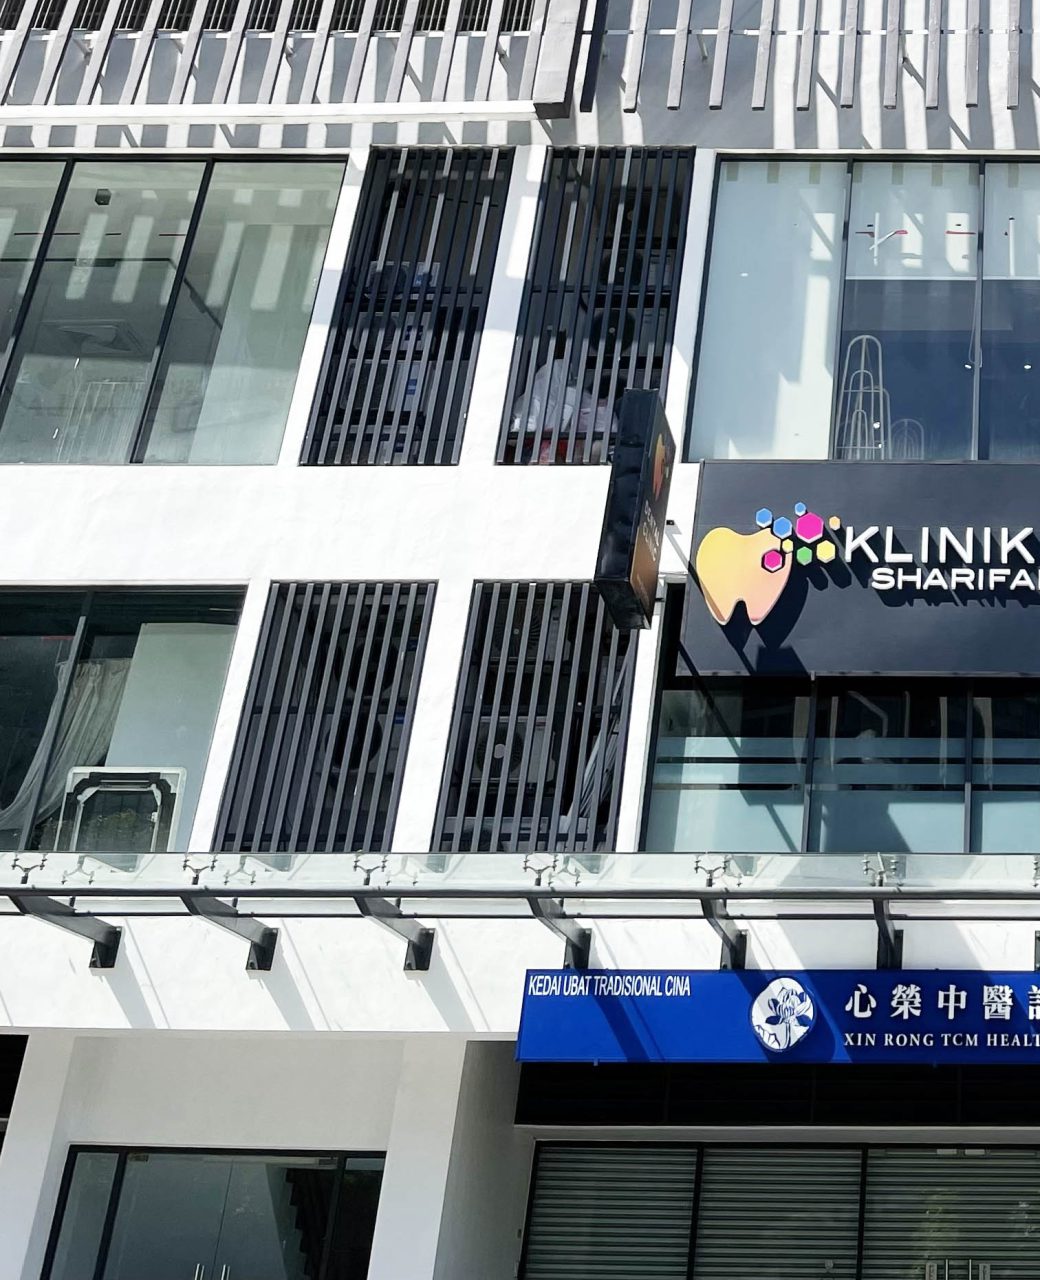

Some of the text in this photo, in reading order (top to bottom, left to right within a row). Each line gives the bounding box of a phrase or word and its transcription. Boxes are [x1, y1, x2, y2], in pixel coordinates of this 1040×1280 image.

[845, 526, 1035, 564] KLINIK
[528, 975, 691, 997] KEDAI UBAT TRADISIONAL CINA
[844, 1033, 877, 1046] XIN
[884, 1033, 934, 1047] RONG
[941, 1033, 978, 1047] TCM
